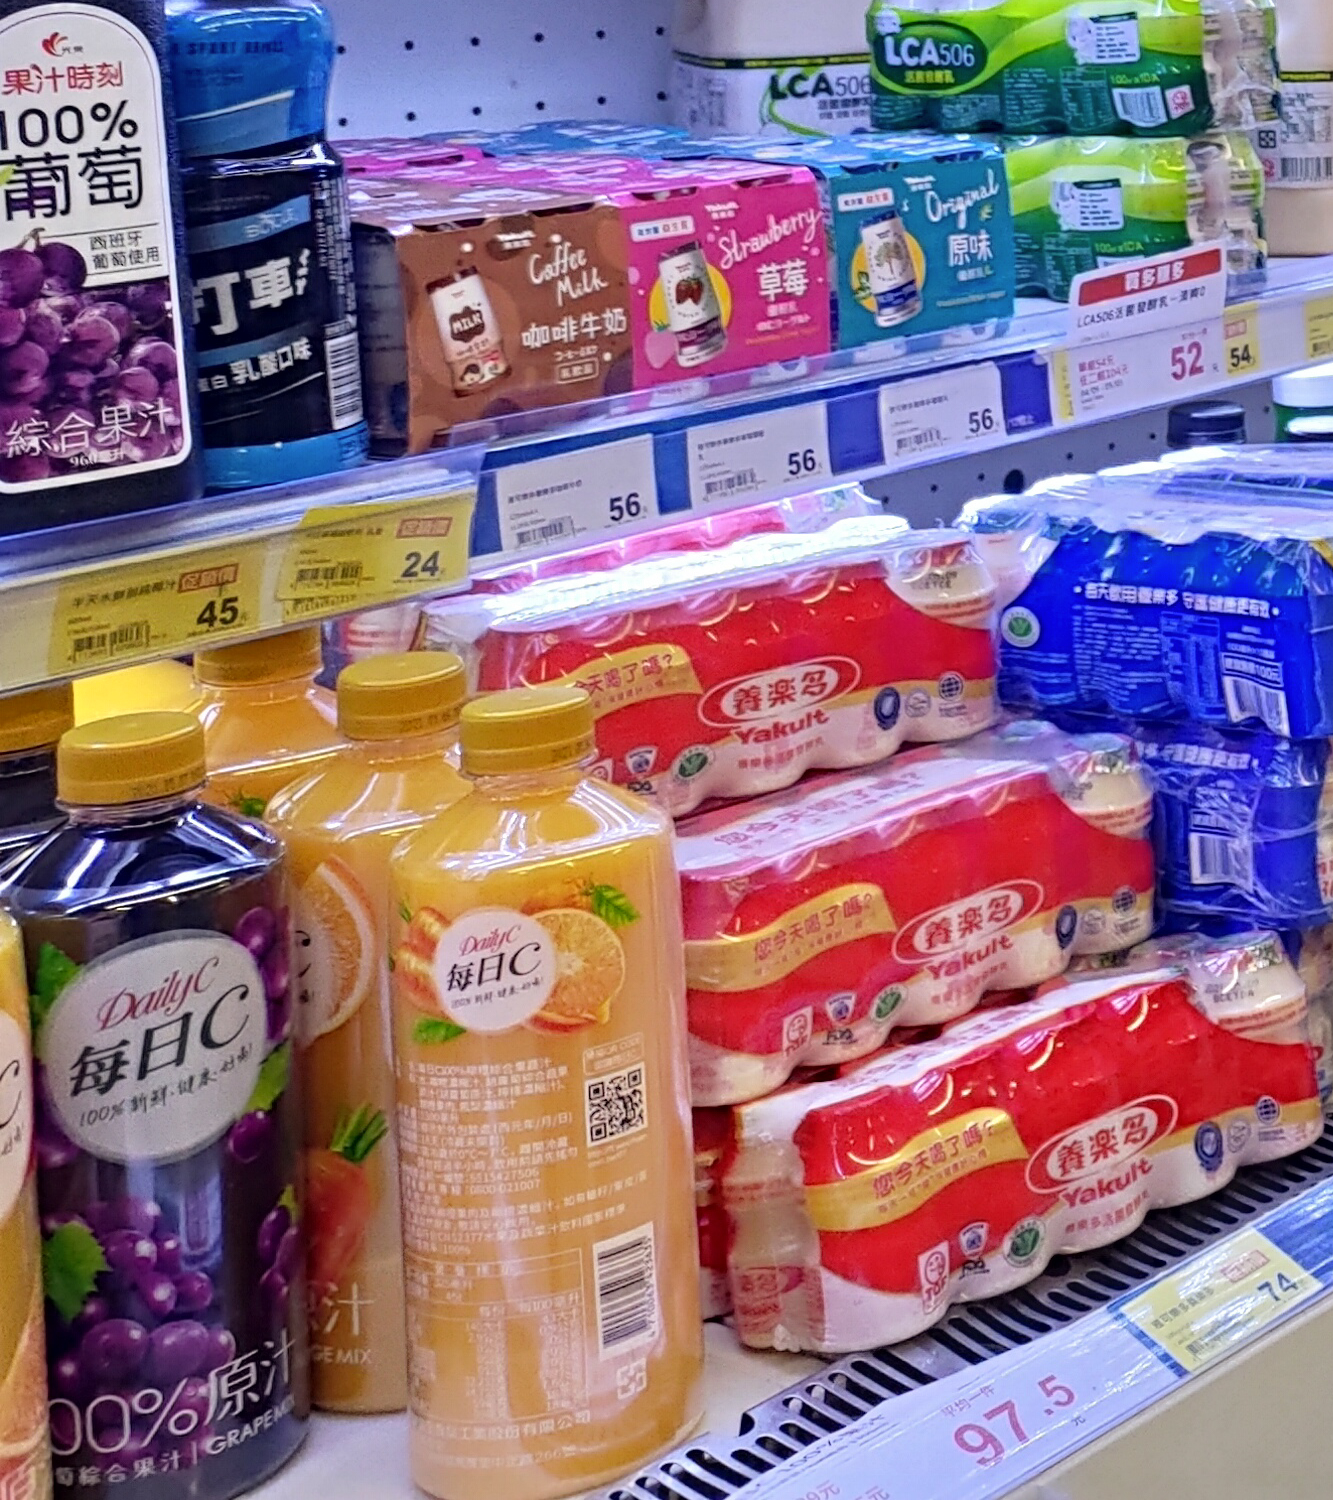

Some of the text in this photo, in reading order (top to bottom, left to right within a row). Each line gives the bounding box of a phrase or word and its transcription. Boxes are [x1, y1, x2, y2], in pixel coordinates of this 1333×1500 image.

[884, 37, 975, 67] LCA506
[2, 61, 124, 96] 果汁時刻
[770, 72, 873, 100] LCA506
[0, 100, 138, 149] 100%
[1, 145, 143, 219] 葡萄
[925, 167, 1000, 223] Original
[89, 230, 143, 250] 西班牙
[90, 246, 162, 271] 葡萄使用
[719, 208, 820, 269] Strawberry
[947, 231, 993, 263] 原味
[528, 240, 587, 288] Coffee
[756, 259, 809, 301] 草莓
[556, 272, 609, 308] Milk
[451, 311, 484, 333] MILK
[520, 307, 628, 350] 咖啡牛奶
[229, 338, 311, 385] 乳酸口味
[1171, 340, 1204, 381] 52
[1230, 344, 1252, 368] 54
[6, 397, 173, 457] 綜合果汁
[968, 408, 994, 432] 56
[788, 448, 816, 476] 56
[609, 491, 641, 522] 56
[401, 550, 440, 579] 24
[197, 597, 239, 628] 45
[733, 708, 830, 747] Yakult
[447, 942, 541, 992] 每日C
[927, 934, 1014, 981] Yakult
[70, 984, 249, 1097] 每日C
[1059, 1157, 1152, 1208] Yakult
[1258, 1272, 1299, 1302] 74
[206, 1412, 273, 1455] GRAPE
[954, 1374, 1074, 1466] 97.5
